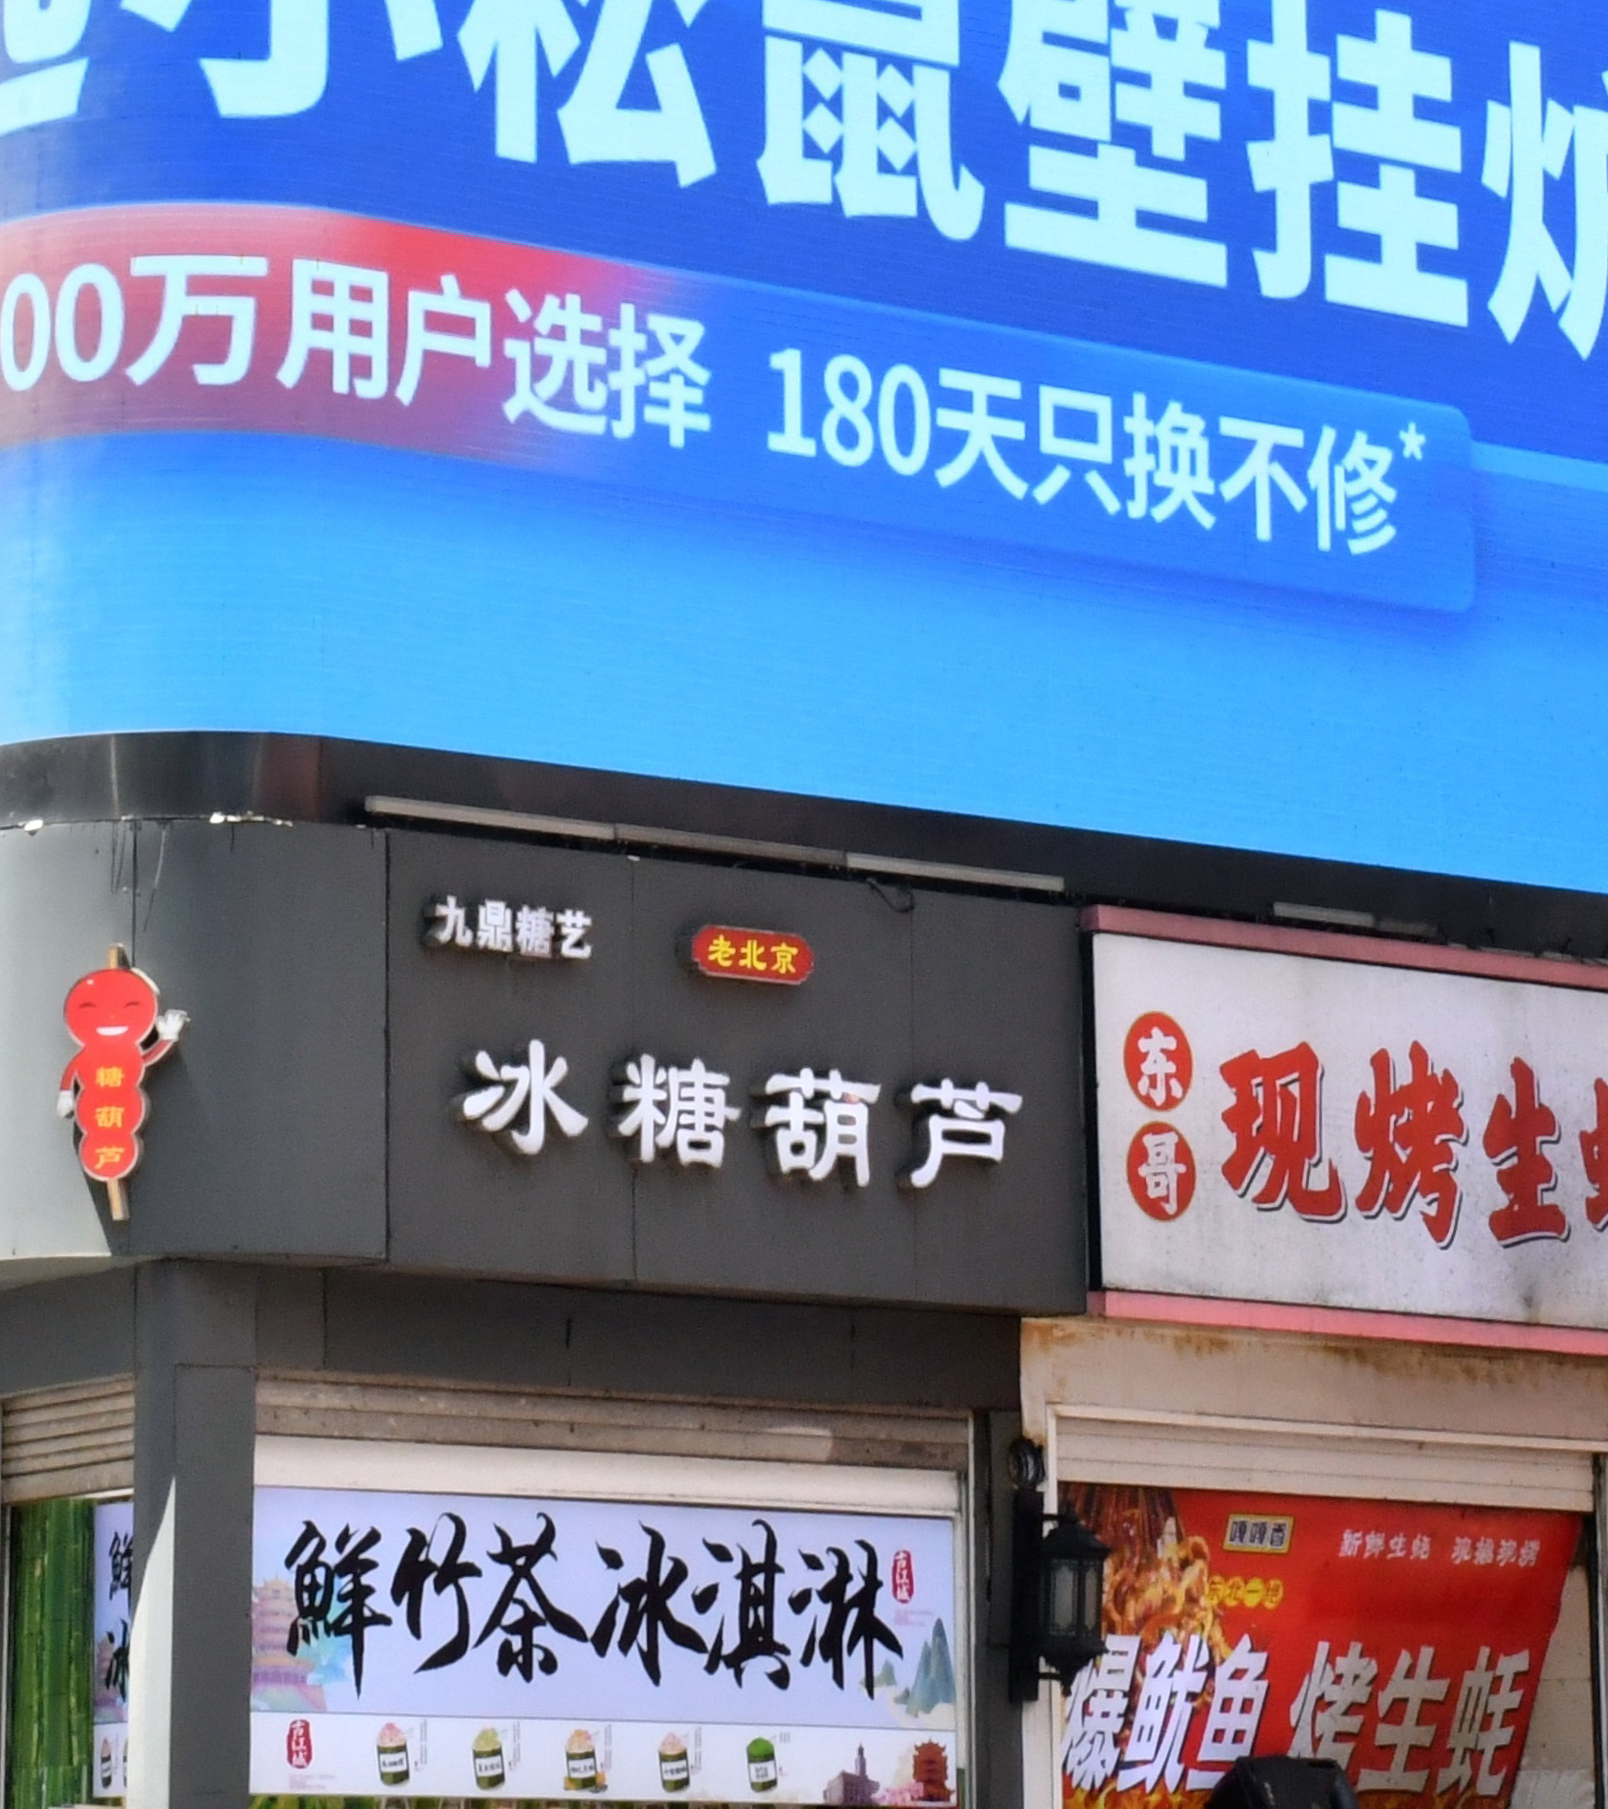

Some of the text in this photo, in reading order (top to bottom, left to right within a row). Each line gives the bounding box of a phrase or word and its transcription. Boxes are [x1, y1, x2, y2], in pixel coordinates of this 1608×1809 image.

[434, 895, 593, 960] 九鼎糖艺
[707, 934, 799, 975] 老北京
[94, 1066, 125, 1170] 糖葫芦
[462, 1039, 1024, 1188] 冰糖葫芦
[1136, 1026, 1187, 1216] 东哥
[1061, 1632, 1531, 1796] 爆鱿鱼 烤生蚝
